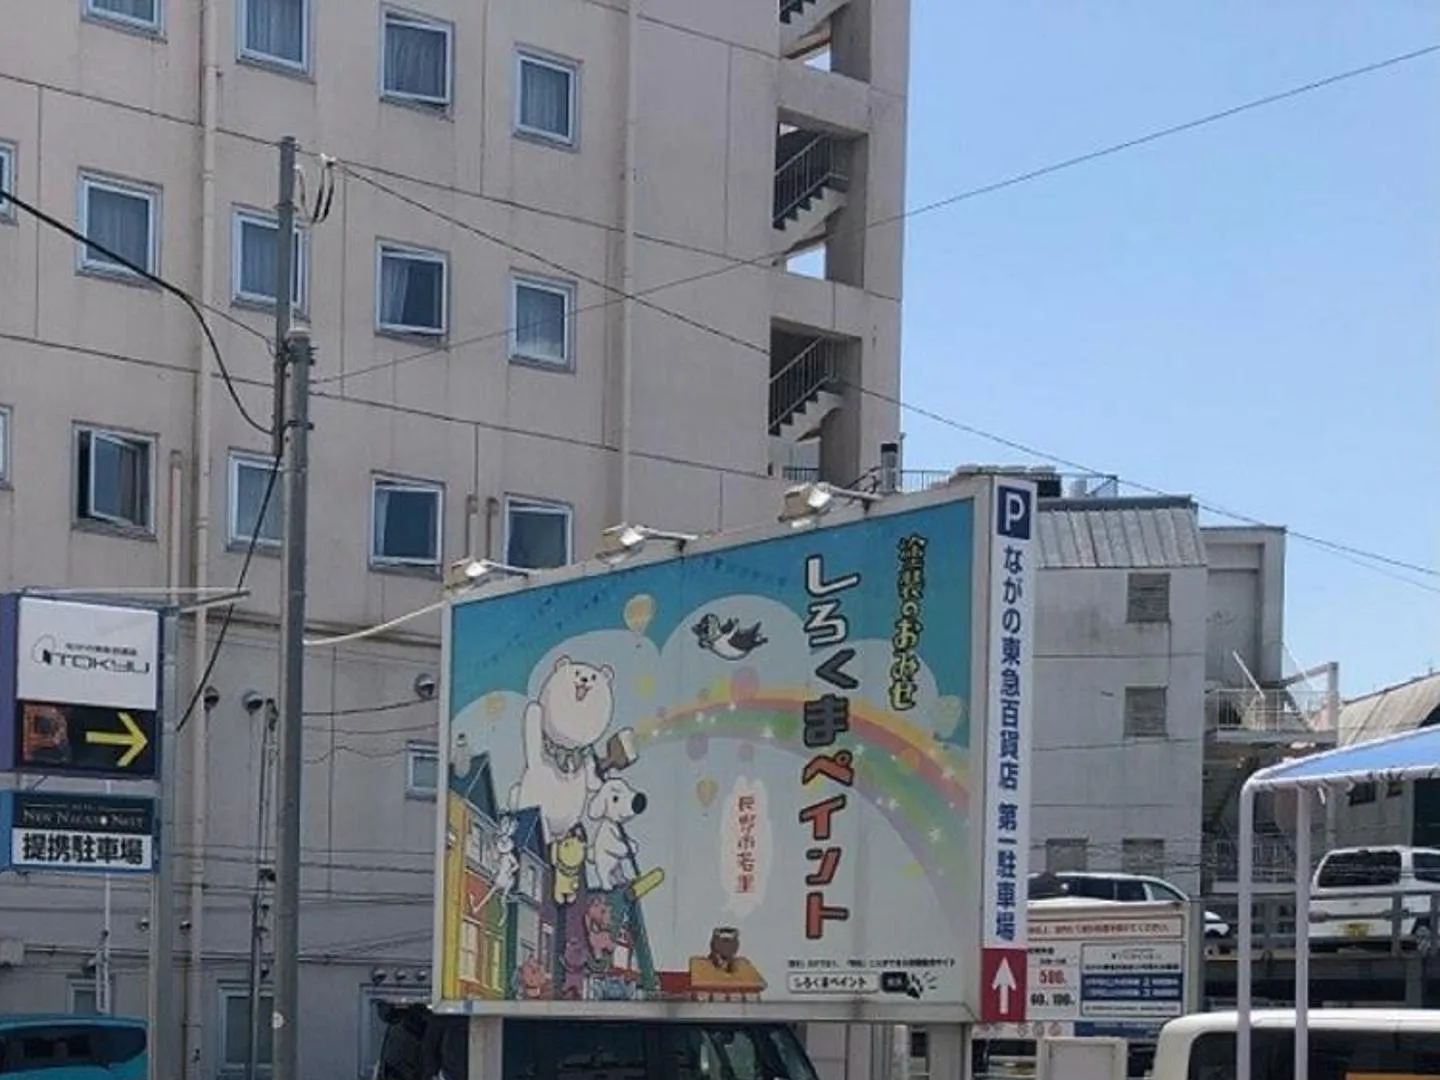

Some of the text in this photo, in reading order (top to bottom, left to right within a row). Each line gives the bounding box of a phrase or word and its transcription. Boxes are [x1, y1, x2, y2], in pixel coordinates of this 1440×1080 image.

[1004, 494, 1026, 532] P
[22, 832, 143, 865] 提携駐車場
[798, 553, 861, 941] しろくまペイント
[994, 545, 1023, 941] ながの東急百貨店 第一駐車場
